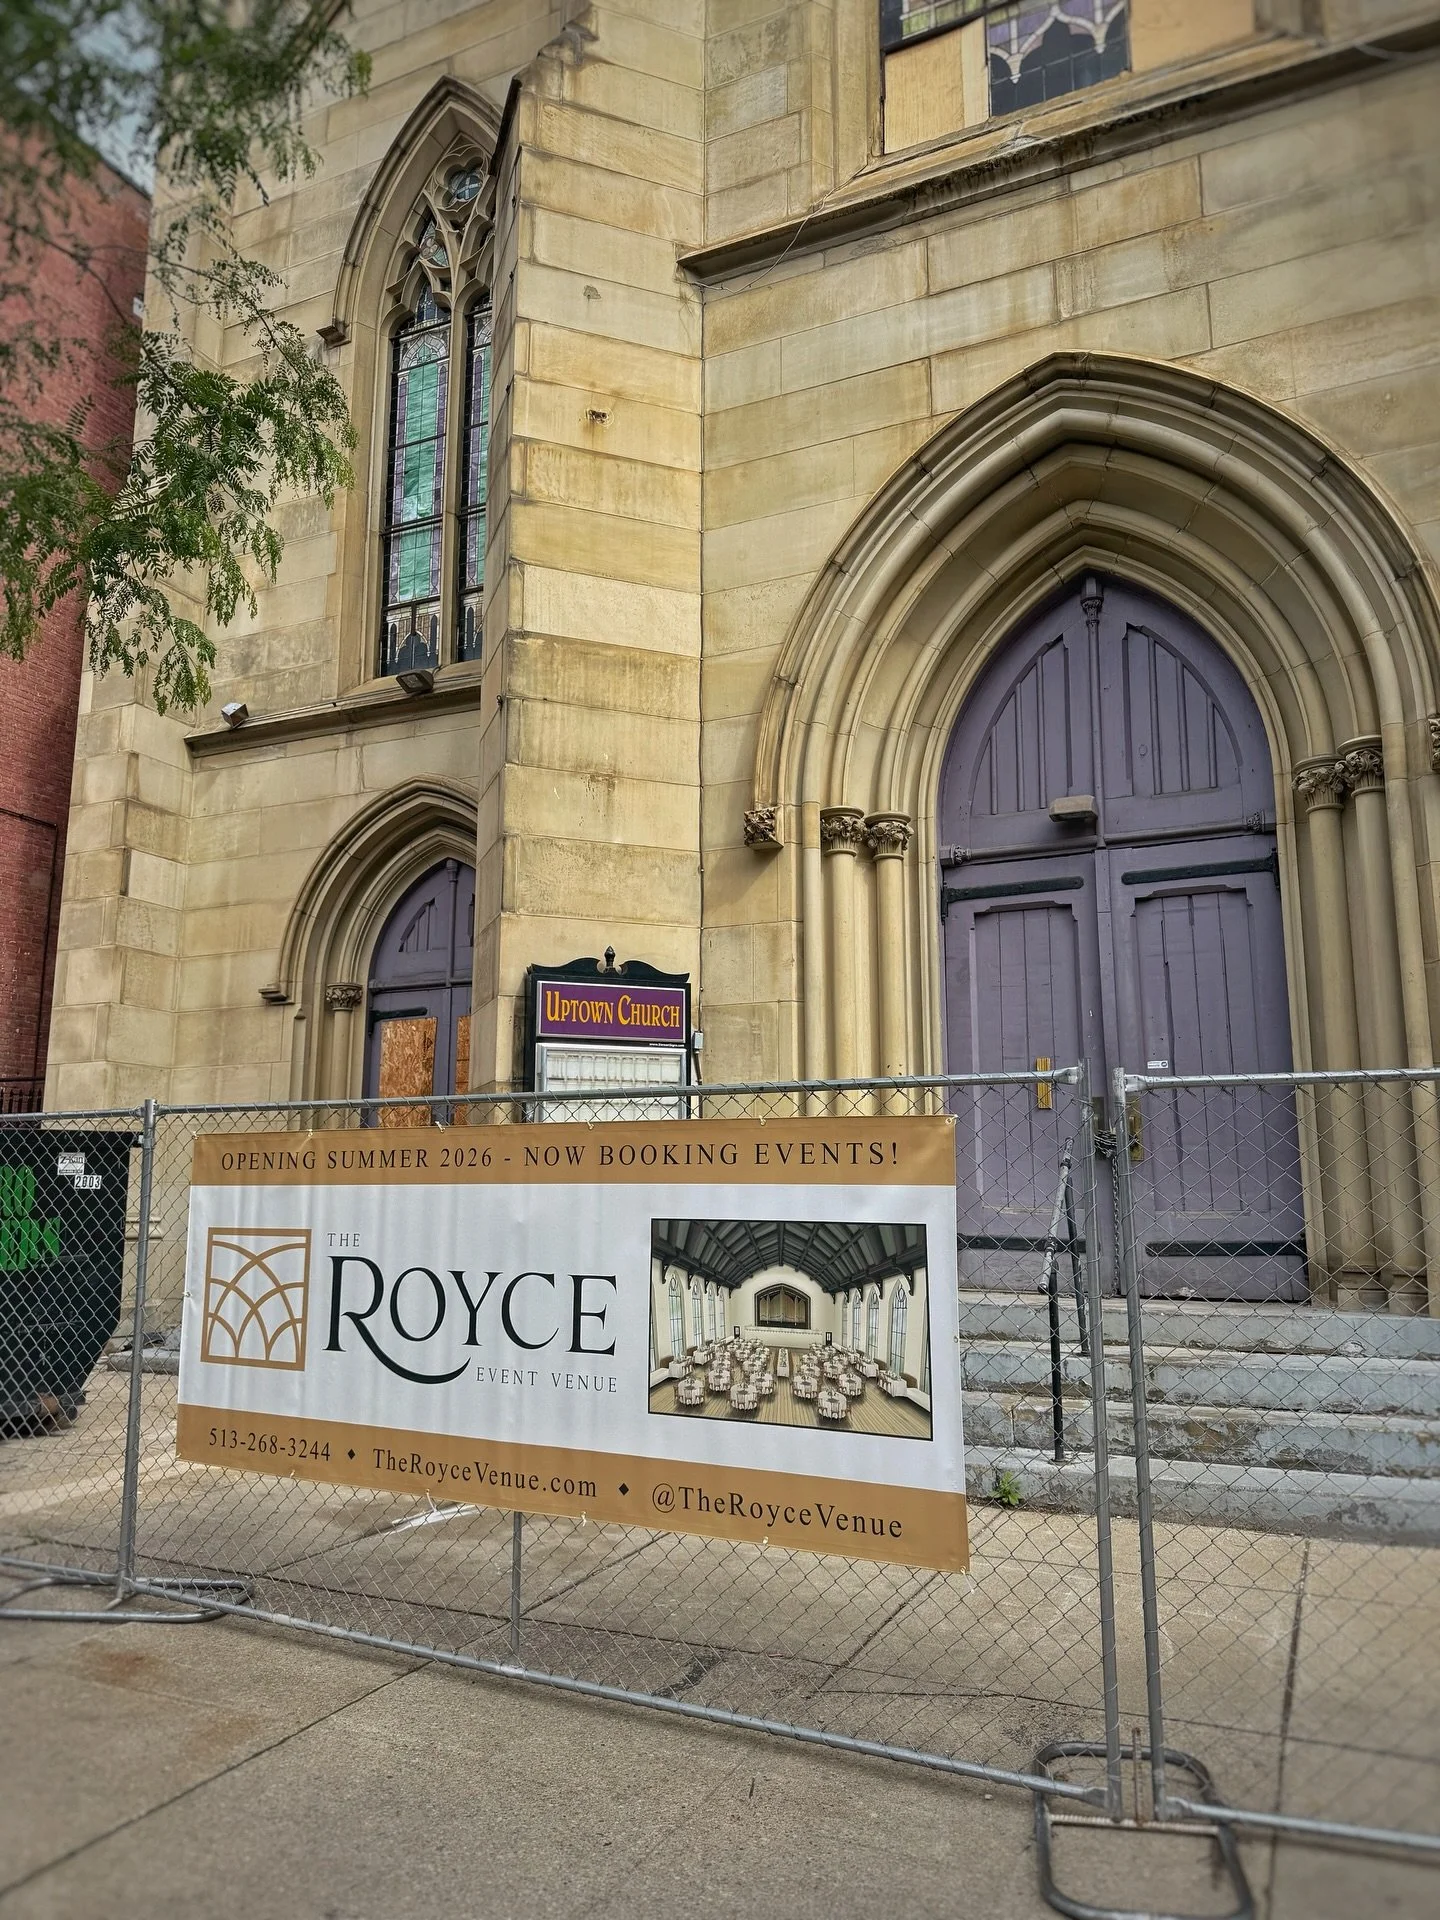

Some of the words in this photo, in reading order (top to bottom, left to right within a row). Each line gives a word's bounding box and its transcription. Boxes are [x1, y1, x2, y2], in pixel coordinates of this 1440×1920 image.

[546, 991, 614, 1024] UPTOWN
[617, 995, 680, 1028] CHURCH
[221, 1150, 317, 1171] OPENING
[327, 1149, 429, 1169] SUMMER
[440, 1147, 492, 1168] 2026
[524, 1145, 585, 1167] NOW
[599, 1143, 739, 1166] BOOKING
[754, 1141, 899, 1165] EVENTS!
[327, 1232, 361, 1248] THE
[322, 1255, 618, 1385] ROYCE
[476, 1366, 538, 1387] EVENT
[551, 1372, 618, 1394] VENUE
[208, 1427, 331, 1462] 513-268-3244
[373, 1447, 598, 1497] TheRoyceVenue.com
[652, 1482, 903, 1539] @TheRoyceVenue
